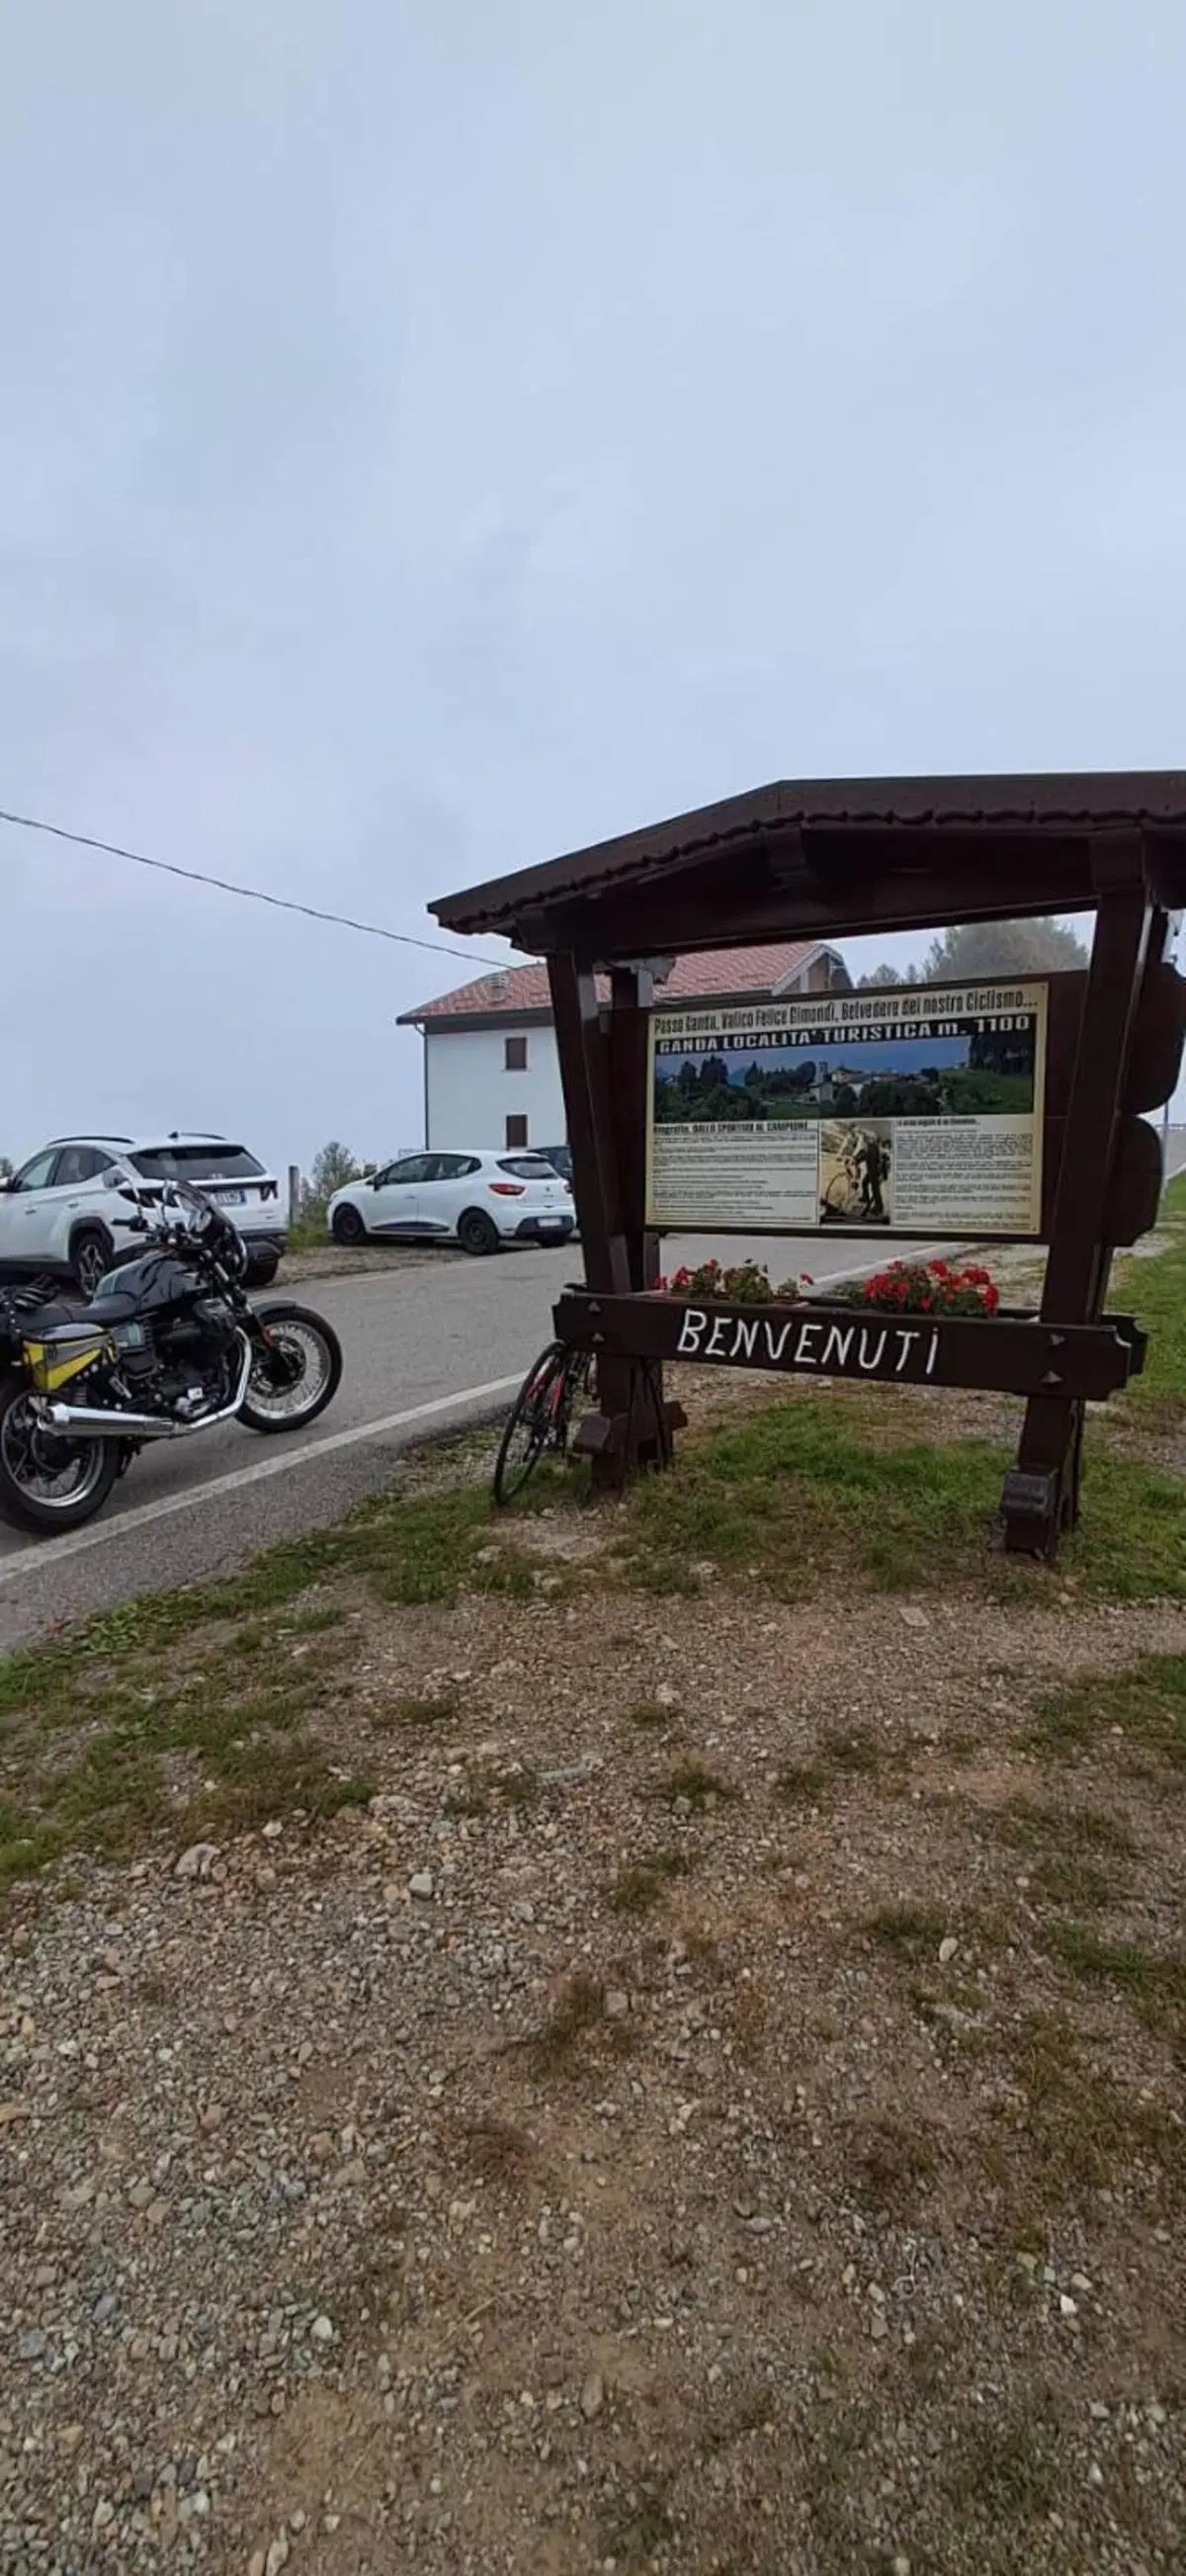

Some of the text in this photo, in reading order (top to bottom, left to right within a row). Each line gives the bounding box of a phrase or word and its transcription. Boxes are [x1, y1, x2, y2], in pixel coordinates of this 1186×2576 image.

[654, 1017, 683, 1036] Passo
[721, 1010, 753, 1030] Valico
[755, 1006, 787, 1027] Felice
[841, 999, 898, 1021] Belvedere
[923, 992, 963, 1014] nostro
[659, 1038, 718, 1054] GANDA
[822, 1020, 932, 1044] TURISTICA
[974, 1014, 1030, 1034] 1100
[677, 1308, 939, 1375] BENVENUTI
